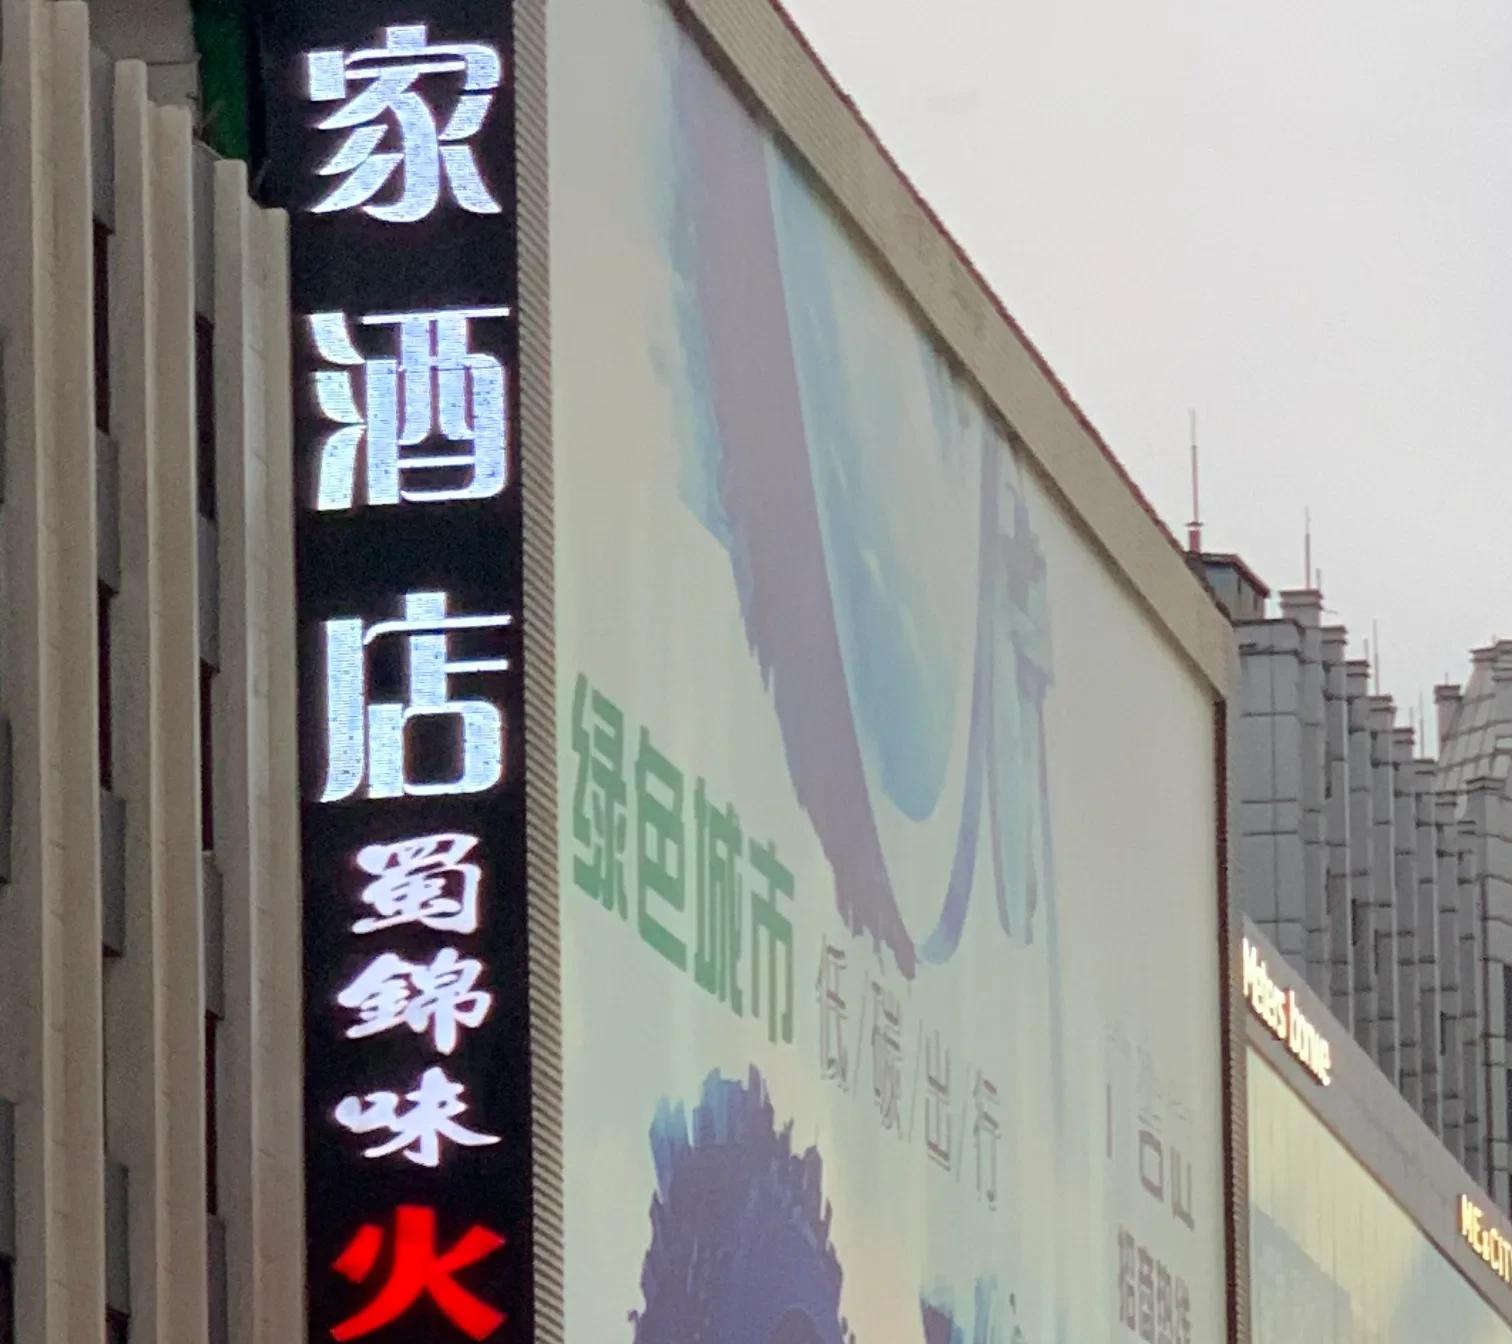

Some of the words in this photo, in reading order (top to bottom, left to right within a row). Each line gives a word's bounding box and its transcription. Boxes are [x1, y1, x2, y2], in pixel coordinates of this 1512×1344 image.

[307, 24, 512, 803] 家酒店
[572, 672, 795, 1044] 绿色城市
